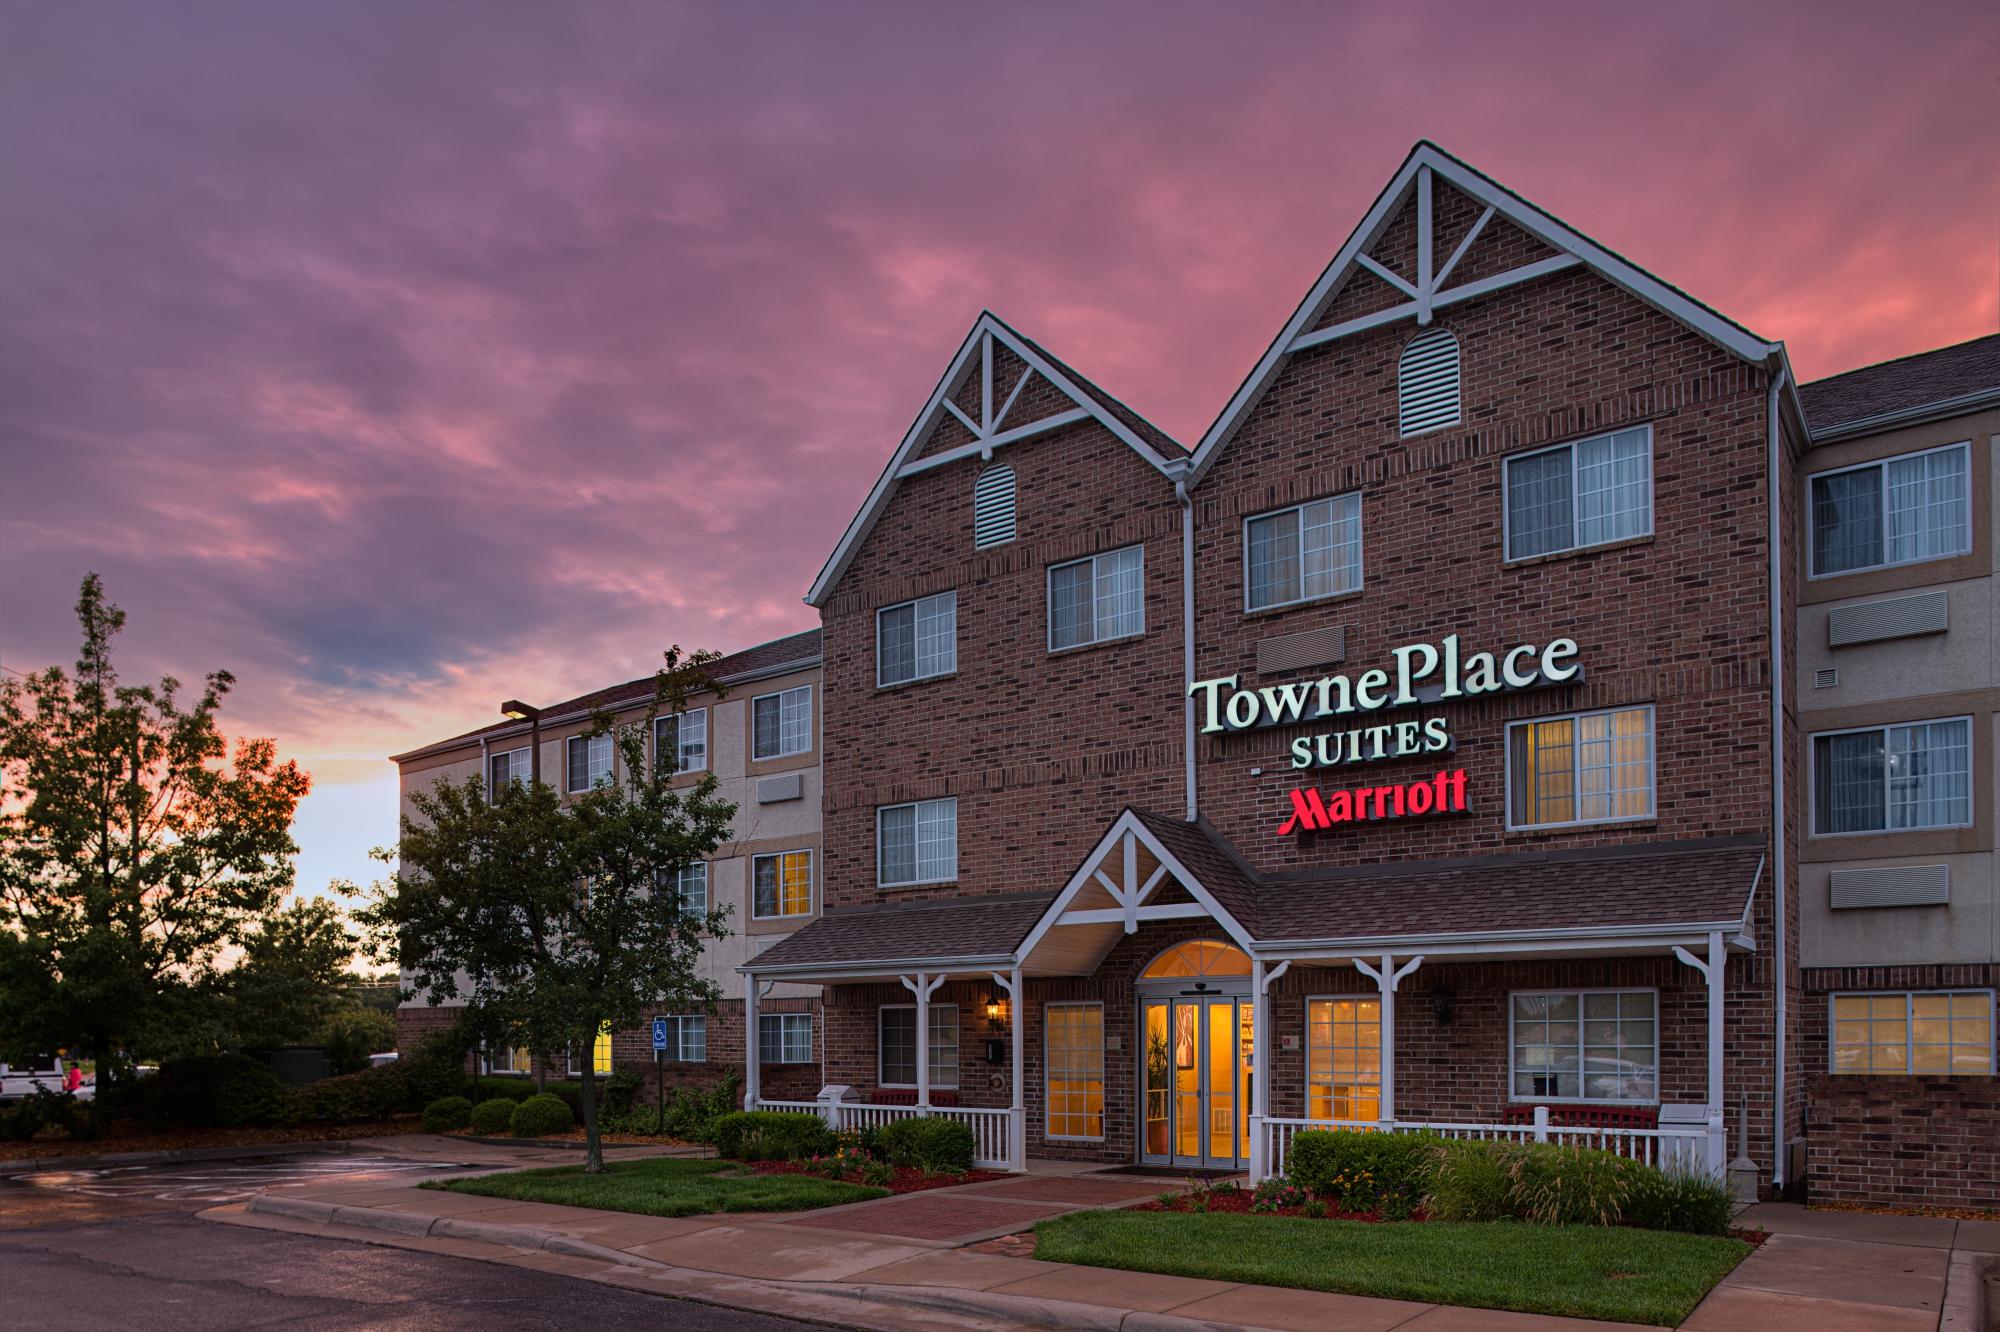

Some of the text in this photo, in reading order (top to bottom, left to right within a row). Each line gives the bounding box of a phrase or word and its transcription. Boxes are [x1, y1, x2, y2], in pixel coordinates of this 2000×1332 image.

[1189, 634, 1579, 733] TownePlace
[1291, 718, 1449, 768] SUITES
[1278, 769, 1469, 835] Marriott
